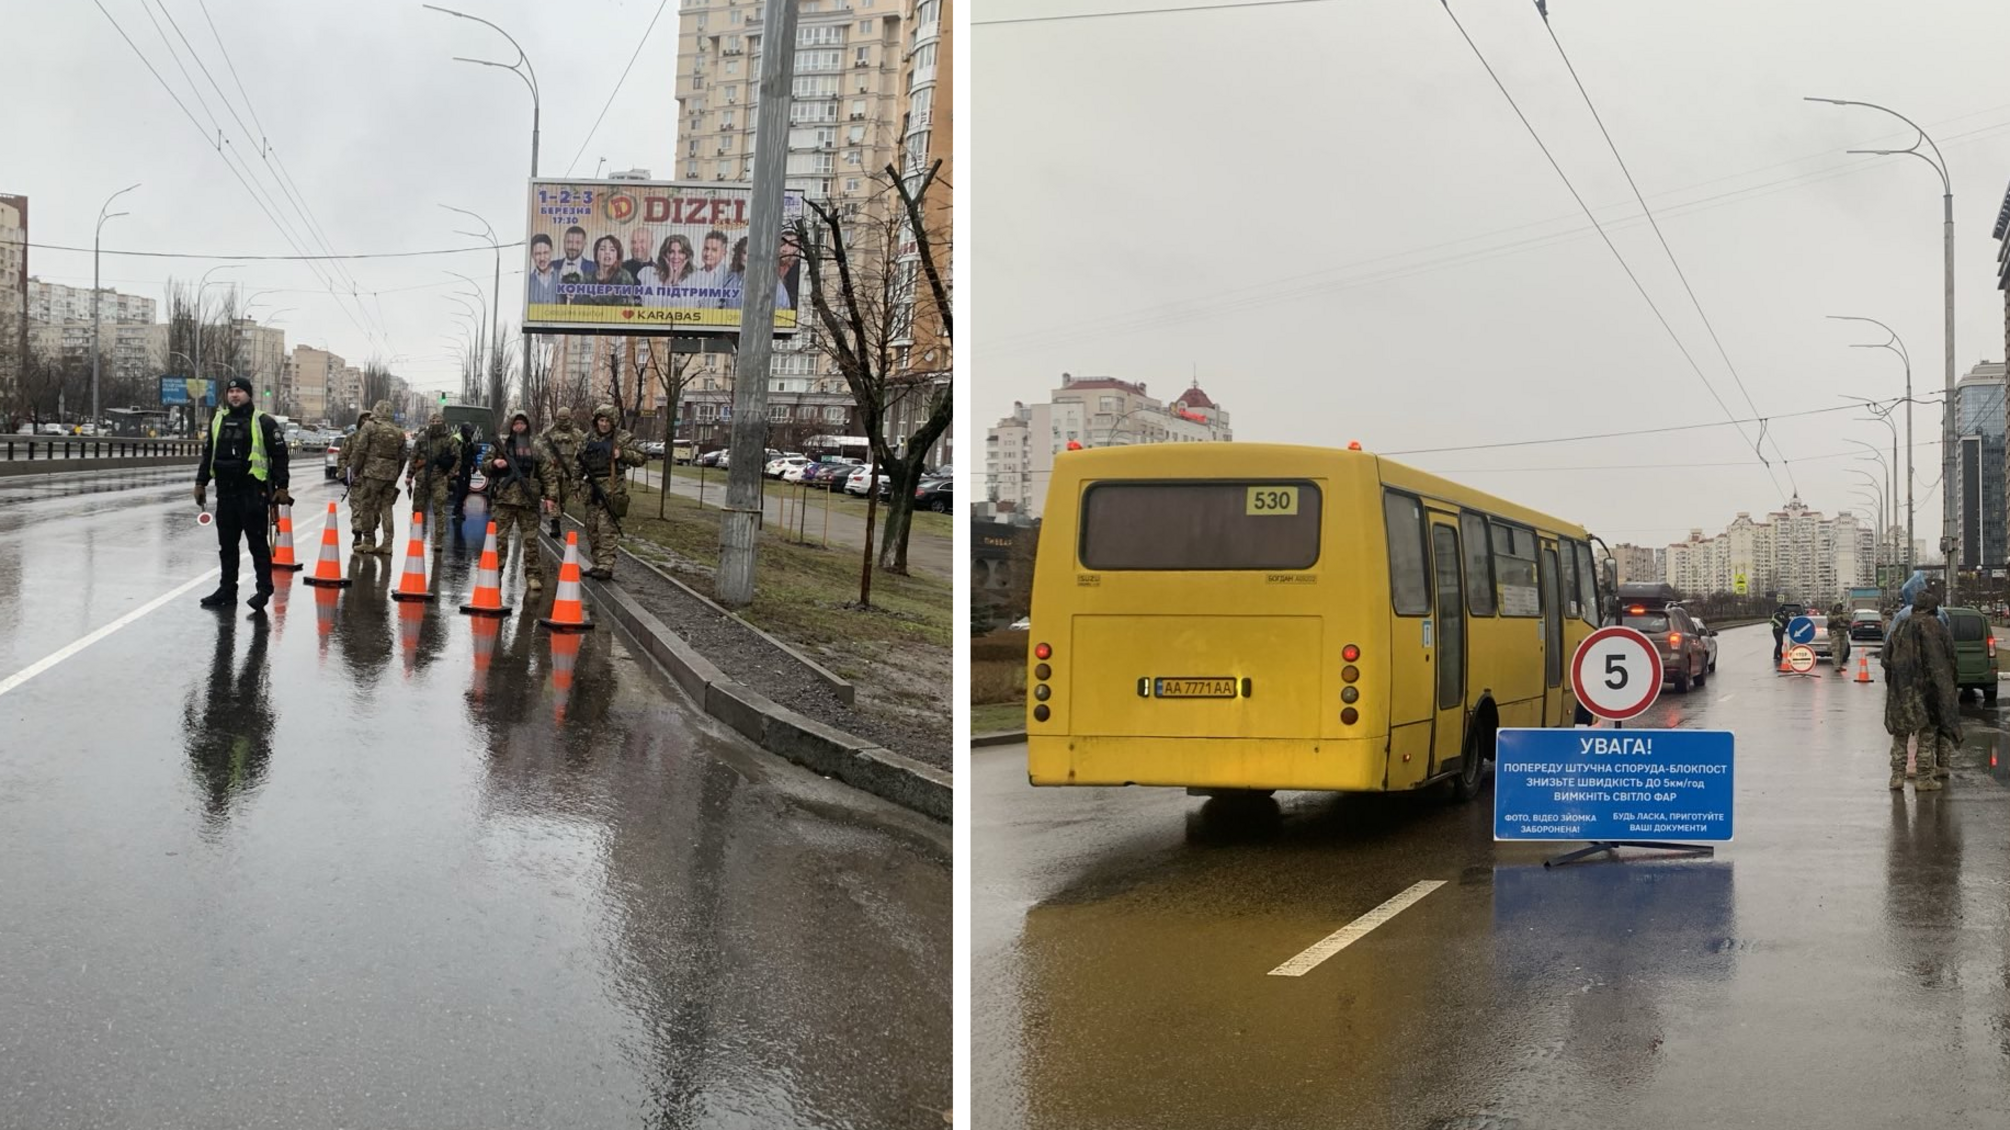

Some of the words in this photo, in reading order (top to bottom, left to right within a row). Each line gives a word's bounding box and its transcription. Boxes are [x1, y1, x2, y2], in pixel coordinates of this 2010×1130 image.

[539, 190, 593, 204] 1-2-3
[540, 207, 592, 215] БЕРЕЗНЯ
[552, 216, 579, 225] 17:30
[556, 284, 632, 296] КОНЦЕРТИ
[634, 285, 654, 296] НА
[656, 286, 740, 299] ПІДТРИМКУ
[637, 310, 702, 321] KARABAS
[1254, 491, 1291, 510] 530
[1604, 653, 1629, 690] 5
[1164, 681, 1181, 694] AA
[1185, 681, 1211, 694] 7771
[1214, 682, 1232, 694] AA
[1580, 737, 1652, 755] УВАГА!
[1503, 762, 1563, 774] ПОПЕРЕДУ
[1565, 763, 1613, 773] ШТУЧНА
[1614, 763, 1728, 775] СПОРУДА-БЛОКПОСТ
[1526, 777, 1575, 787] ЗНИЗЬТЕ
[1577, 777, 1643, 788] ШВИДКІСТЬ
[1645, 778, 1661, 788] ДО
[1663, 778, 1705, 789] 5км/год
[1554, 791, 1611, 801] ВИМКНІТЬ
[1612, 791, 1652, 802] СВІТЛО
[1653, 792, 1678, 802] ФАР
[1504, 813, 1531, 822] ФОТО,
[1532, 814, 1559, 823] ВІДЕО
[1560, 812, 1597, 822] ЗЙОМКА
[1612, 812, 1636, 821] БУДЬ
[1636, 812, 1668, 821] ЛАСКА,
[1669, 811, 1725, 821] ПРИГОТУЙТЕ
[1520, 825, 1580, 834] ЗАБОРОНЕНА!
[1629, 824, 1652, 832] ВАШІ
[1653, 824, 1707, 833] ДОКУМЕНТИ
